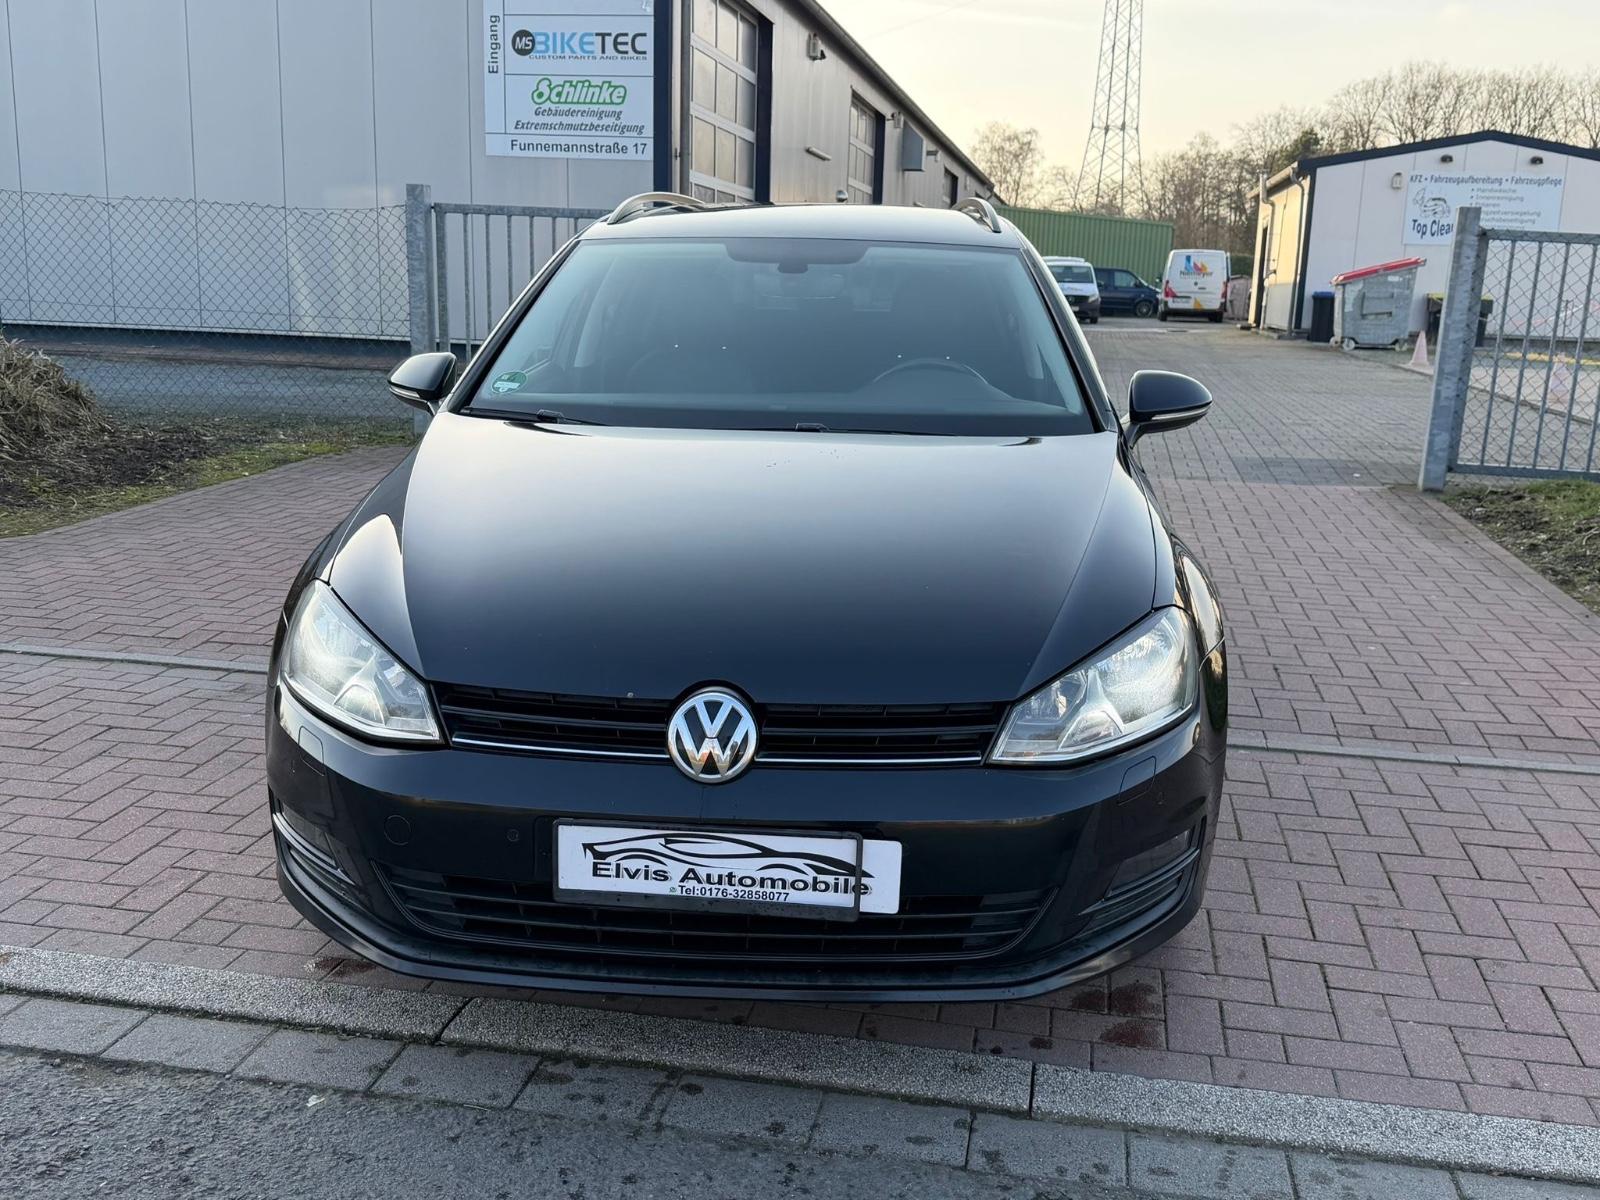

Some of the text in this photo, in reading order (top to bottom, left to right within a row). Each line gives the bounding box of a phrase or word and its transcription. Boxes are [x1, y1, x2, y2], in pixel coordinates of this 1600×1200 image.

[488, 14, 500, 74] Eingang
[515, 31, 648, 55] MS BIKETEC
[531, 77, 627, 105] Schlinke
[534, 106, 623, 121] Gebäudereinigung
[514, 119, 645, 136] Extremschmutzbeseitigung
[510, 139, 647, 155] Funnemannstraße 17
[1409, 174, 1562, 187] KFZ Fahrzeugaufbereitung Fahrzeugpflege
[1412, 219, 1428, 239] Top
[592, 862, 871, 895] Elvis Automobile
[678, 885, 789, 902] Tel:0176-32858077
